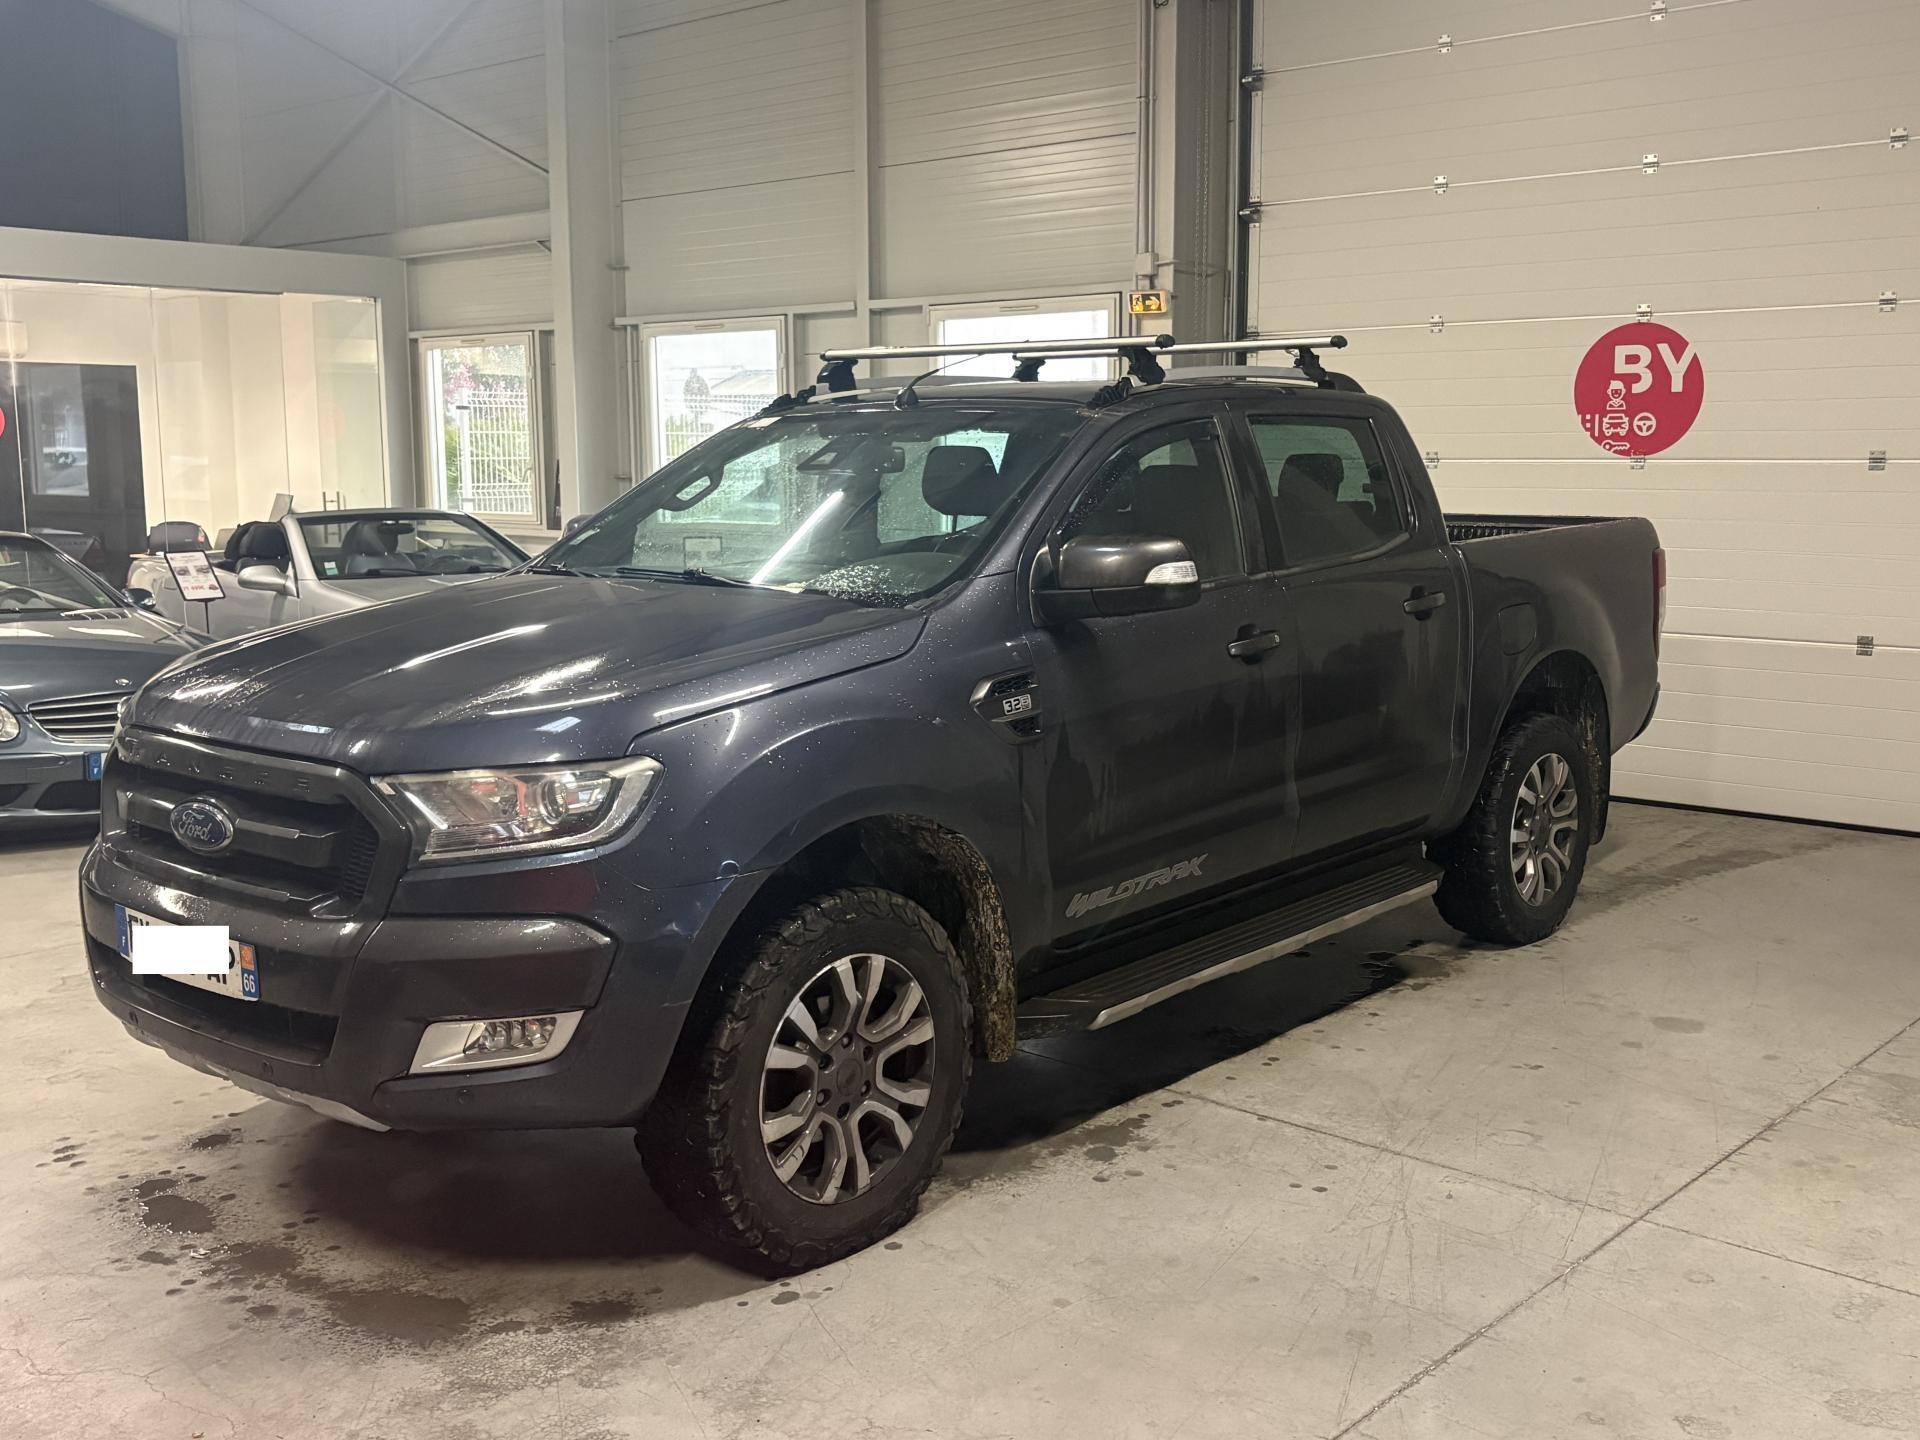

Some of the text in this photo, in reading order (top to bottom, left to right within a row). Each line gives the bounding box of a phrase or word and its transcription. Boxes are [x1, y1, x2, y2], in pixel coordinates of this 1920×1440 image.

[1614, 343, 1697, 394] BY
[177, 809, 212, 841] Ford
[1065, 853, 1209, 919] WILDTRAK
[243, 973, 256, 993] 66
